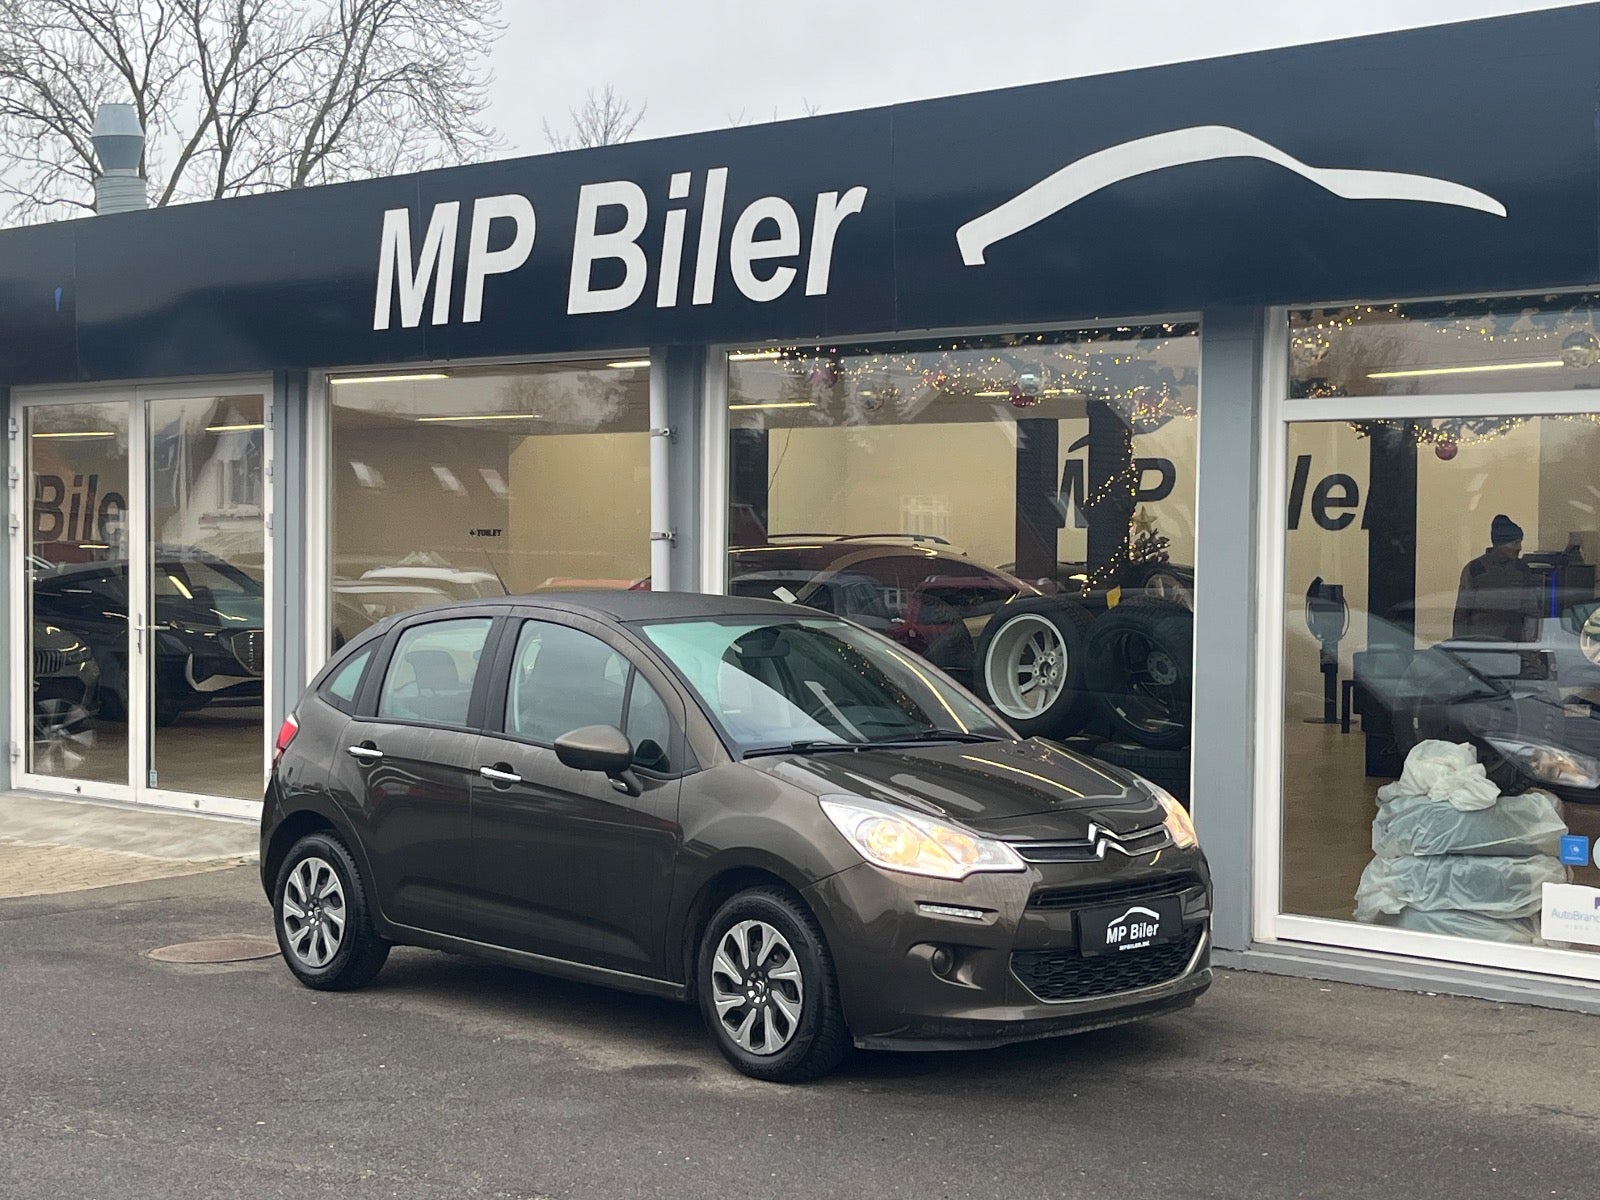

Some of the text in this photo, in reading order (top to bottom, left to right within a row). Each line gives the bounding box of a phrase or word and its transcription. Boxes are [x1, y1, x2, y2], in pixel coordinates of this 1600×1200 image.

[373, 166, 869, 331] MP Biler
[477, 528, 502, 537] TOILET
[1105, 922, 1160, 944] MP Biler
